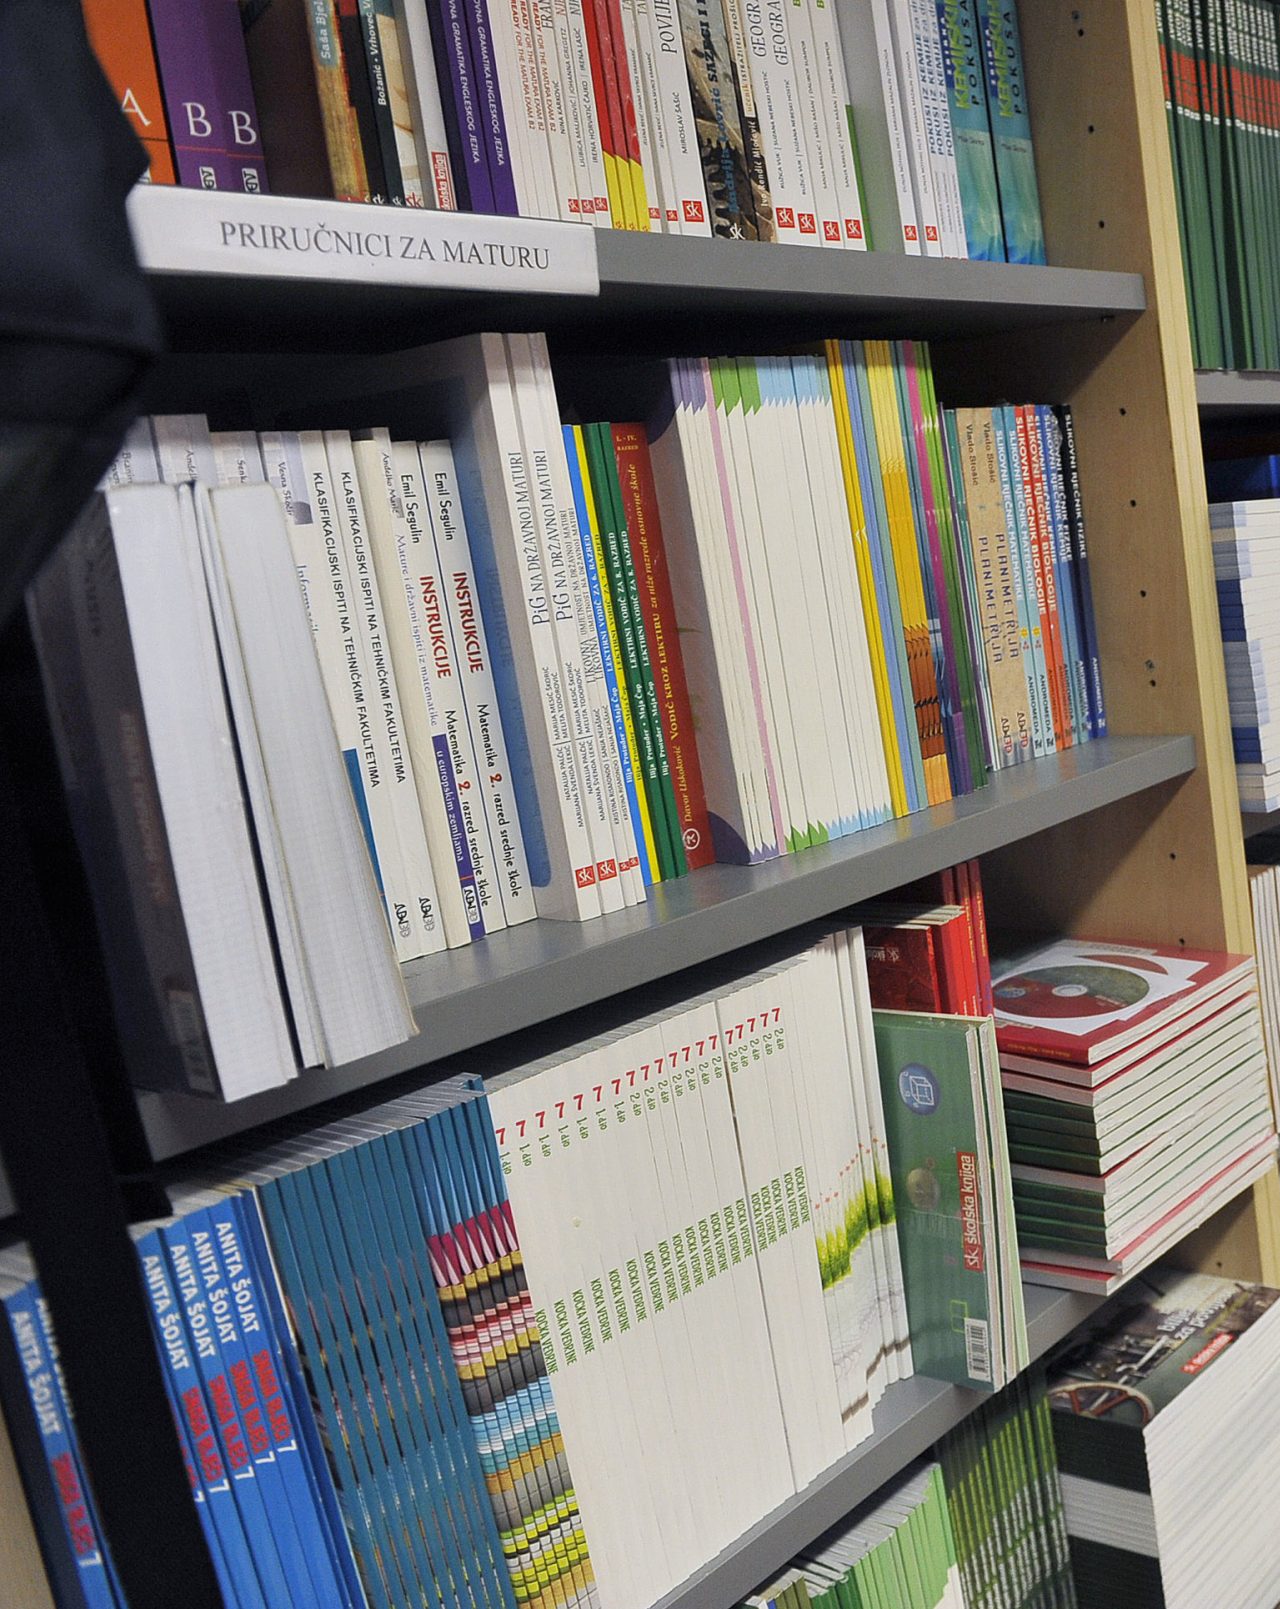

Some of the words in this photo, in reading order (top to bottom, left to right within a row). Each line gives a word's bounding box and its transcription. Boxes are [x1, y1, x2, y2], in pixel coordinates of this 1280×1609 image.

[452, 21, 467, 75] GRAMATIKA
[460, 76, 476, 132] ENGLESKOG
[469, 132, 481, 164] JEZIKA
[477, 26, 492, 80] GRAMATIKA
[486, 81, 501, 133] ENGLESKOG
[494, 132, 504, 166] JEZIKA
[182, 102, 212, 137] B
[227, 110, 257, 145] B
[220, 221, 391, 258] PRIRUČNICI
[400, 235, 435, 261] ZA
[443, 240, 549, 271] MATURU
[1026, 415, 1040, 479] SLIKOVNI
[401, 474, 416, 498] Emil
[434, 472, 450, 496] Emil
[508, 452, 529, 502] MATURI
[533, 450, 553, 501] MATURI
[312, 472, 341, 577] KLASIFIKACIJSKI
[341, 471, 368, 575] KLASIFIKACIJSKI
[406, 502, 422, 544] Segulin
[440, 500, 457, 541] Segulin
[1016, 417, 1030, 481] SLIKOVNI
[1024, 483, 1037, 541] RJEČNIK
[1031, 544, 1047, 616] BIOLOGIJE
[517, 506, 541, 572] DRŽAVNOJ
[542, 504, 564, 571] DRŽAVNOJ
[608, 532, 620, 568] RAZRED
[332, 579, 346, 614] ISPITI
[359, 576, 373, 611] ISPITI
[527, 573, 543, 595] NA
[552, 572, 567, 593] NA
[978, 537, 1003, 663] PLANIMETRIJA
[995, 533, 1019, 658] PLANIMETRIJA
[340, 616, 351, 634] NA
[368, 613, 378, 631] NA
[452, 571, 484, 674] INSTRUKCIJE
[528, 596, 551, 625] PiG
[552, 594, 573, 621] PiG
[420, 575, 452, 679] INSTRUKCIJE
[652, 613, 668, 664] LEKTIRU
[624, 627, 638, 669] LEKTIRNI
[343, 636, 366, 704] TEHNIČKIM
[370, 634, 391, 699] TEHNIČKIM
[661, 665, 675, 699] KROZ
[357, 705, 381, 788] FAKULTETIMA
[383, 702, 406, 784] FAKULTETIMA
[446, 710, 464, 775] Matematika
[477, 704, 496, 768] Matematika
[458, 780, 470, 796] 2.
[489, 772, 502, 788] 2.
[462, 800, 477, 834] razred
[493, 793, 510, 827] razred
[469, 837, 483, 876] srednje
[500, 829, 514, 868] srednje
[477, 878, 490, 907] škole
[507, 869, 520, 898] škole
[772, 1007, 781, 1022] 7
[725, 1030, 734, 1045] 7
[535, 1111, 546, 1128] 7
[554, 1102, 565, 1118] 7
[573, 1094, 584, 1111] 7
[496, 1127, 506, 1145] 7
[516, 1120, 526, 1137] 7
[783, 1172, 794, 1199] KOCKA
[794, 1166, 806, 1193] KOCKA
[959, 1155, 974, 1193] knjiga
[787, 1197, 800, 1230] VEDRINE
[798, 1190, 811, 1224] VEDRINE
[962, 1196, 977, 1245] školska
[964, 1247, 980, 1269] sk
[192, 1231, 220, 1288] ANITA
[209, 1288, 237, 1345] ŠOJAT
[215, 1221, 244, 1278] ANITA
[232, 1278, 260, 1334] ŠOJAT
[142, 1255, 171, 1315] ANITA
[160, 1314, 190, 1371] ŠOJAT
[170, 1244, 199, 1302] ANITA
[187, 1302, 216, 1359] ŠOJAT
[554, 1299, 569, 1331] KOCKA
[572, 1289, 587, 1320] KOCKA
[534, 1308, 550, 1341] KOCKA
[578, 1317, 595, 1355] VEDRINE
[541, 1338, 559, 1376] VEDRINE
[560, 1328, 578, 1366] VEDRINE
[255, 1451, 276, 1465] 7
[277, 1439, 298, 1453] 7
[208, 1479, 230, 1494] 7
[234, 1466, 255, 1481] 7
